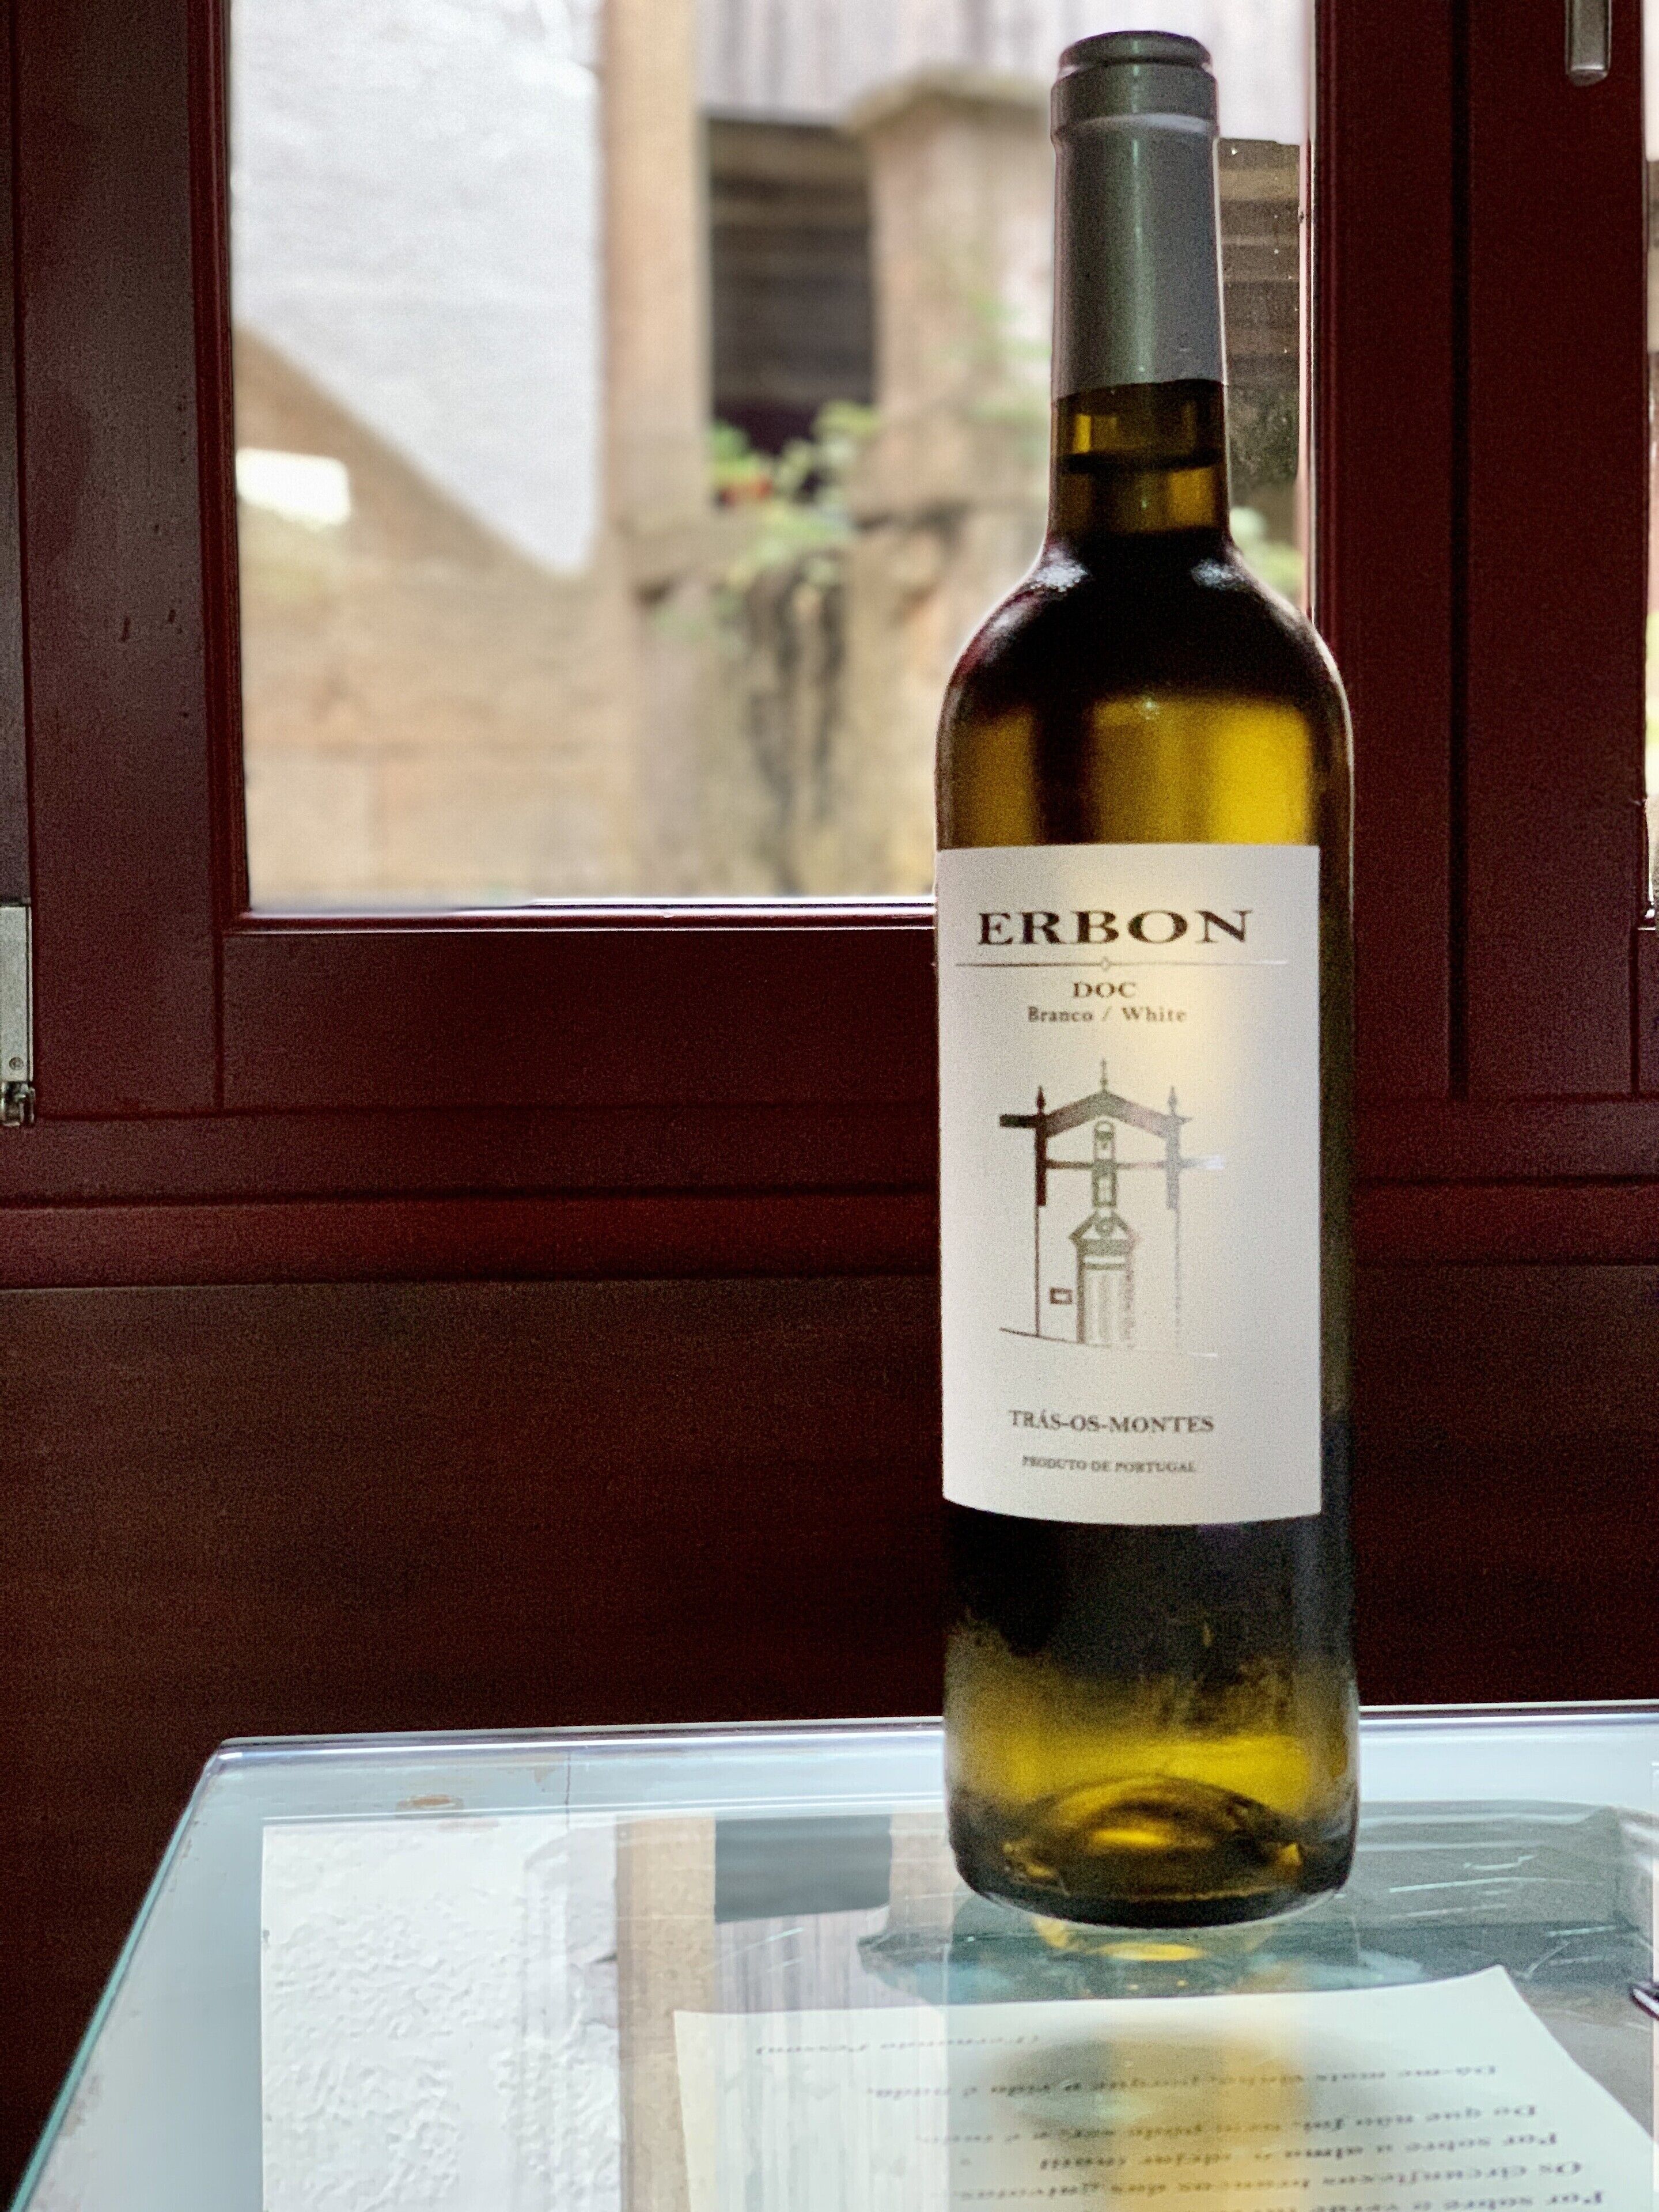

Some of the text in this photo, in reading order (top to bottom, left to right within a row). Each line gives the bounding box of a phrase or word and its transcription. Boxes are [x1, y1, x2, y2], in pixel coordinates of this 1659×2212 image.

[979, 908, 1253, 945] ERBON
[1073, 981, 1136, 998] DOC
[1028, 1006, 1187, 1022] Branco / White
[1009, 1409, 1214, 1433] TRÁS-OS-MONTES
[1022, 1455, 1197, 1474] PRODUTO DE PORTUGAL
[1426, 2107, 1482, 2123] que
[1406, 2137, 1491, 2153] sobre
[1501, 2132, 1558, 2146] Por
[1285, 2146, 1364, 2161] alma
[1323, 2165, 1528, 2187] circunflexos
[1539, 2161, 1582, 2177] Os
[1444, 2197, 1533, 2211] sobre
[1546, 2191, 1604, 2206] Por
